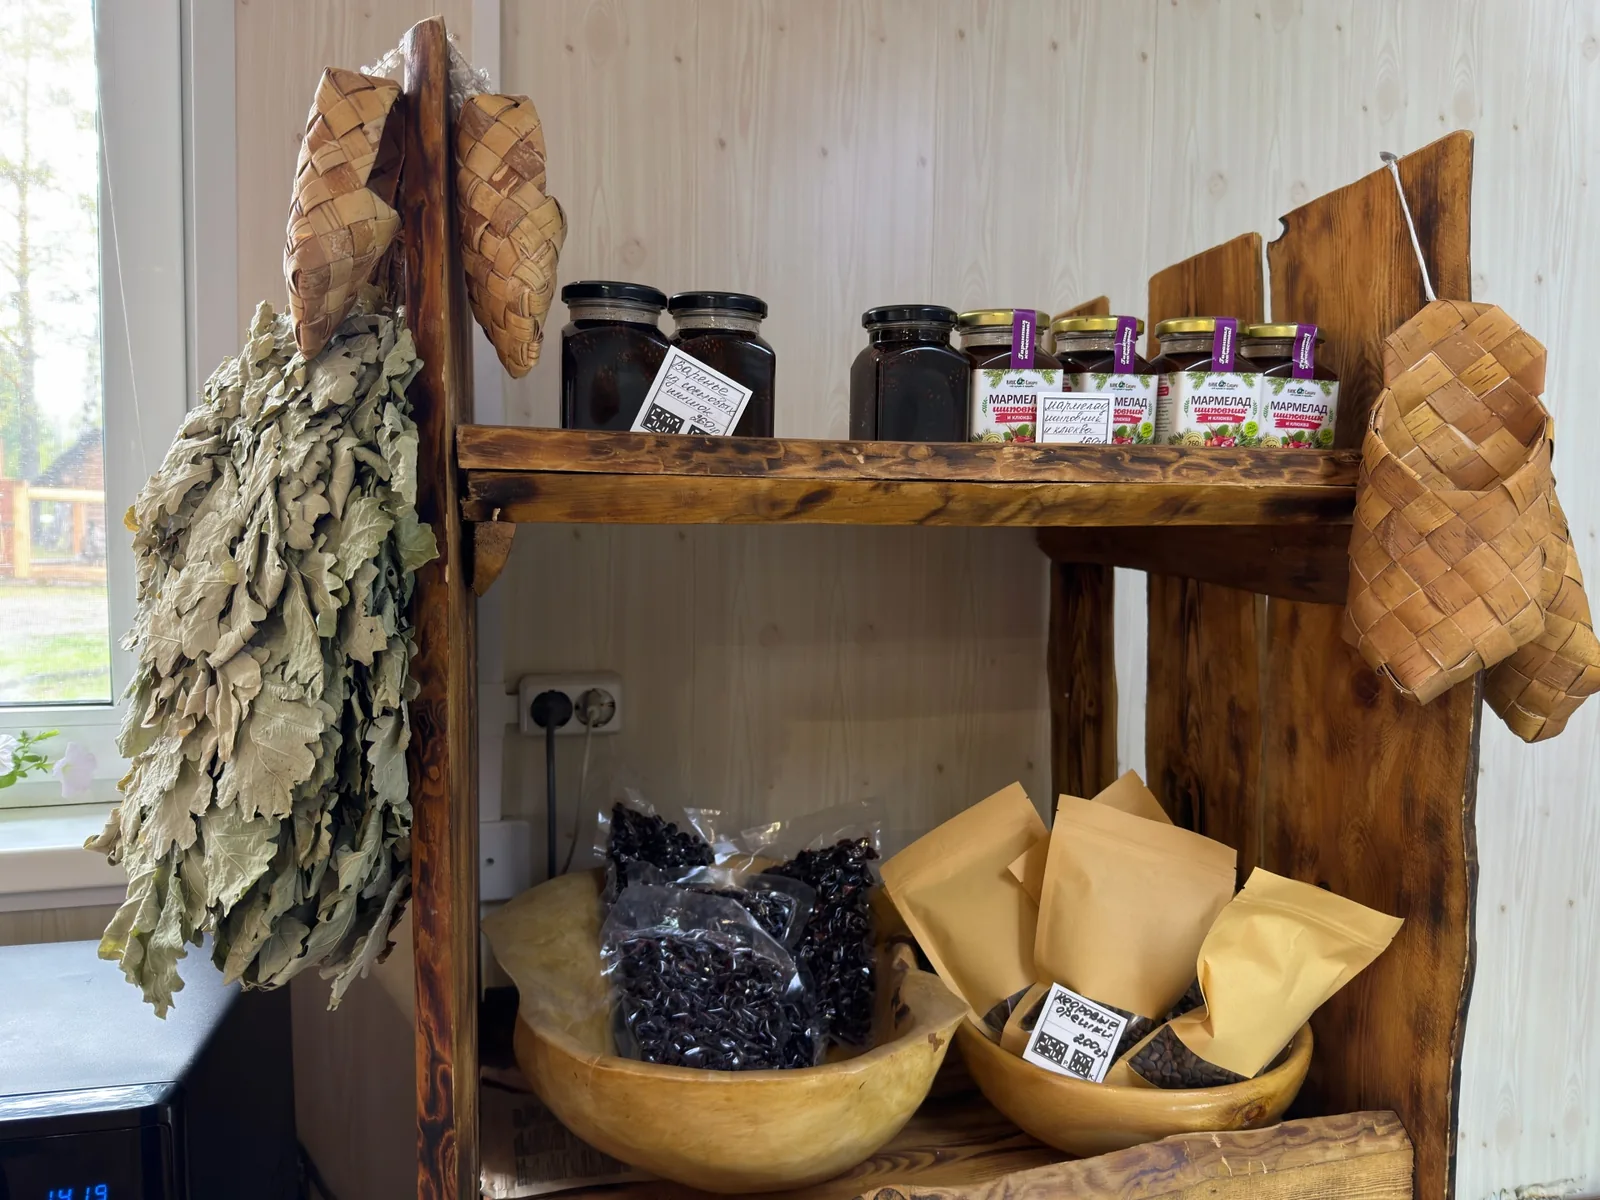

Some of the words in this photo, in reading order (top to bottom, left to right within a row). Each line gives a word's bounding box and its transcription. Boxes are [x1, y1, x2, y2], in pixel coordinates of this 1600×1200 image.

[672, 360, 728, 396] Варенье
[666, 374, 679, 388] из
[682, 381, 736, 415] сосновых
[989, 394, 1037, 404] МАРМЕЛ
[1114, 397, 1147, 408] МЕЛАД
[1191, 396, 1251, 408] МАРМЕЛАД
[1270, 401, 1328, 416] МАРМЕЛАД
[1045, 412, 1102, 423] шиповник
[1273, 412, 1324, 421] шиповник
[1053, 424, 1095, 434] клюква
[1056, 1006, 1112, 1038] орешки
[1073, 1034, 1108, 1058] 200гр
[1036, 1035, 1066, 1061] 250
[1071, 1053, 1092, 1075] 00
